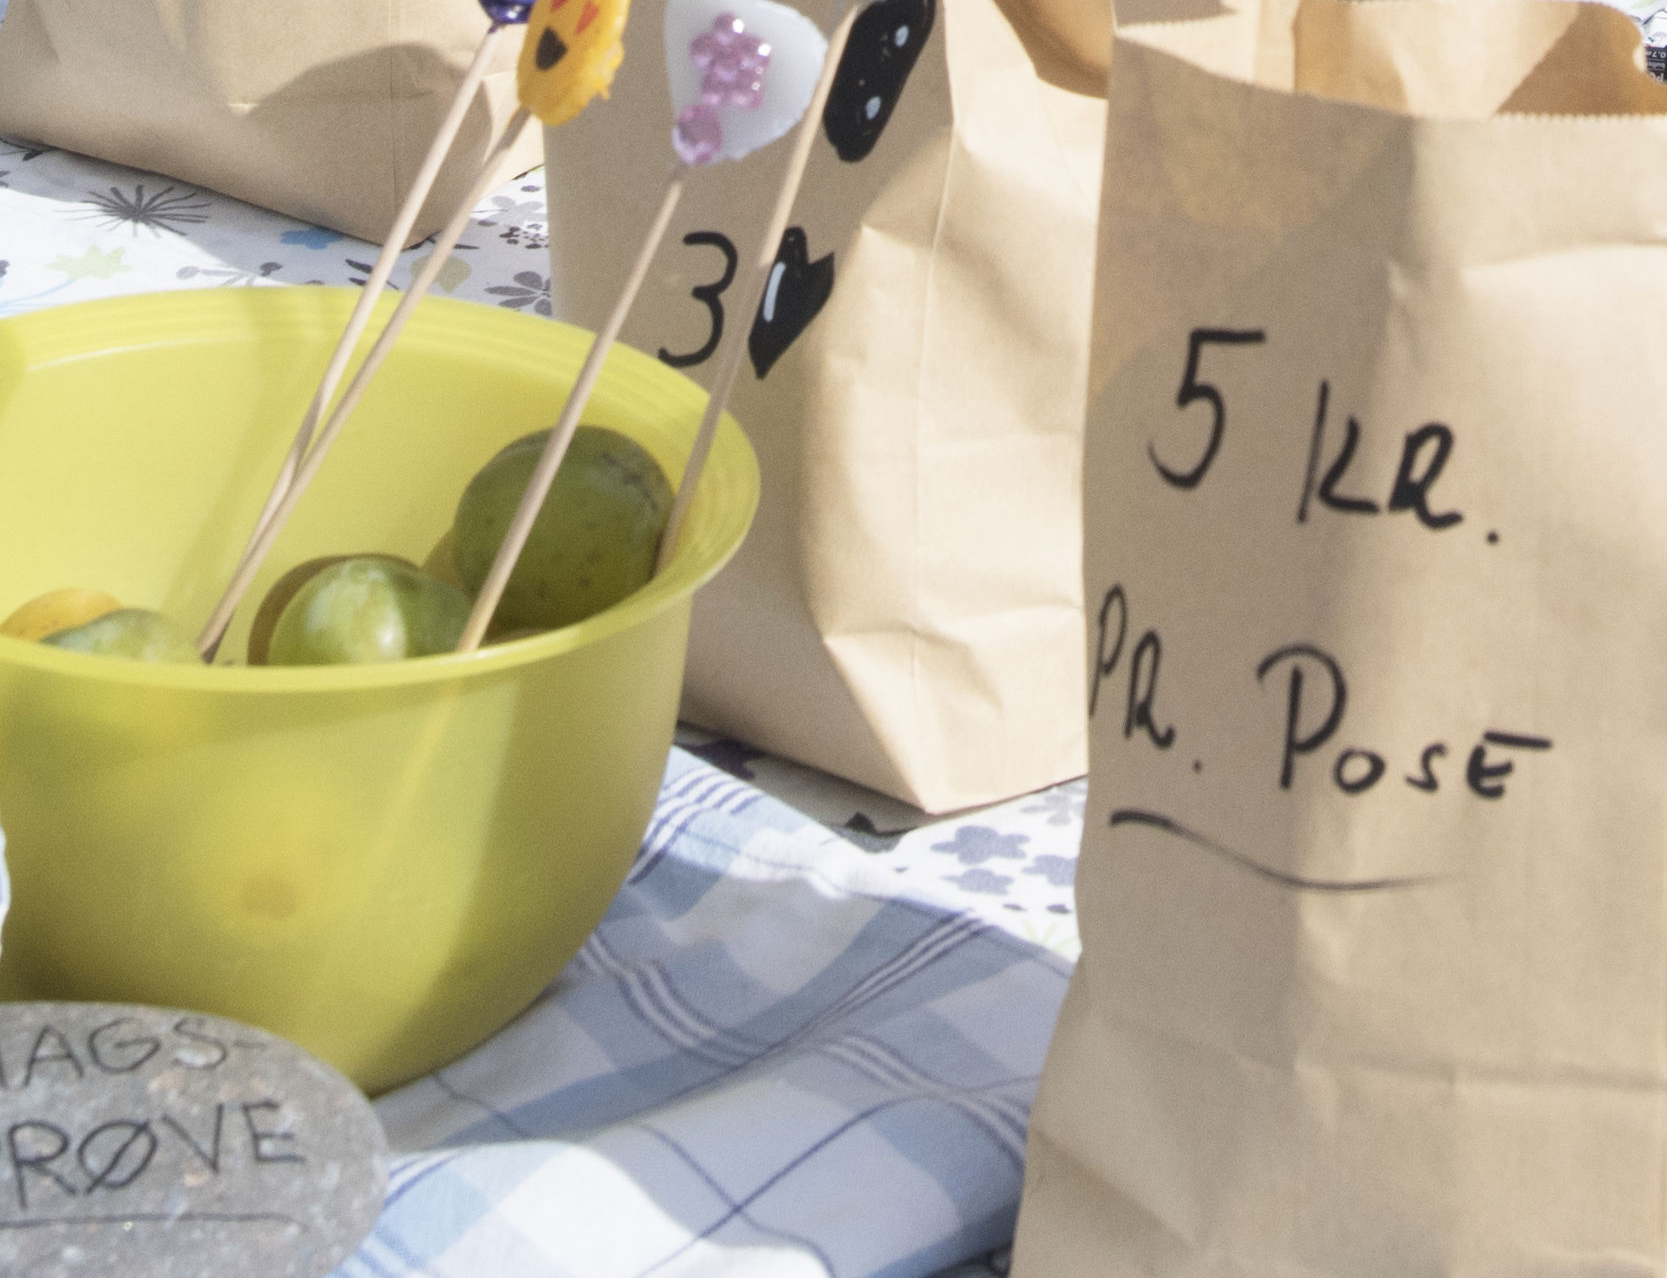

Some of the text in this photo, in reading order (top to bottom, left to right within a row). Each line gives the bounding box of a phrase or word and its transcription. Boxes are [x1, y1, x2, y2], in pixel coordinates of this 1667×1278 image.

[658, 232, 737, 367] 3
[1149, 330, 1265, 489] 5
[0, 1017, 267, 1089] AGS-
